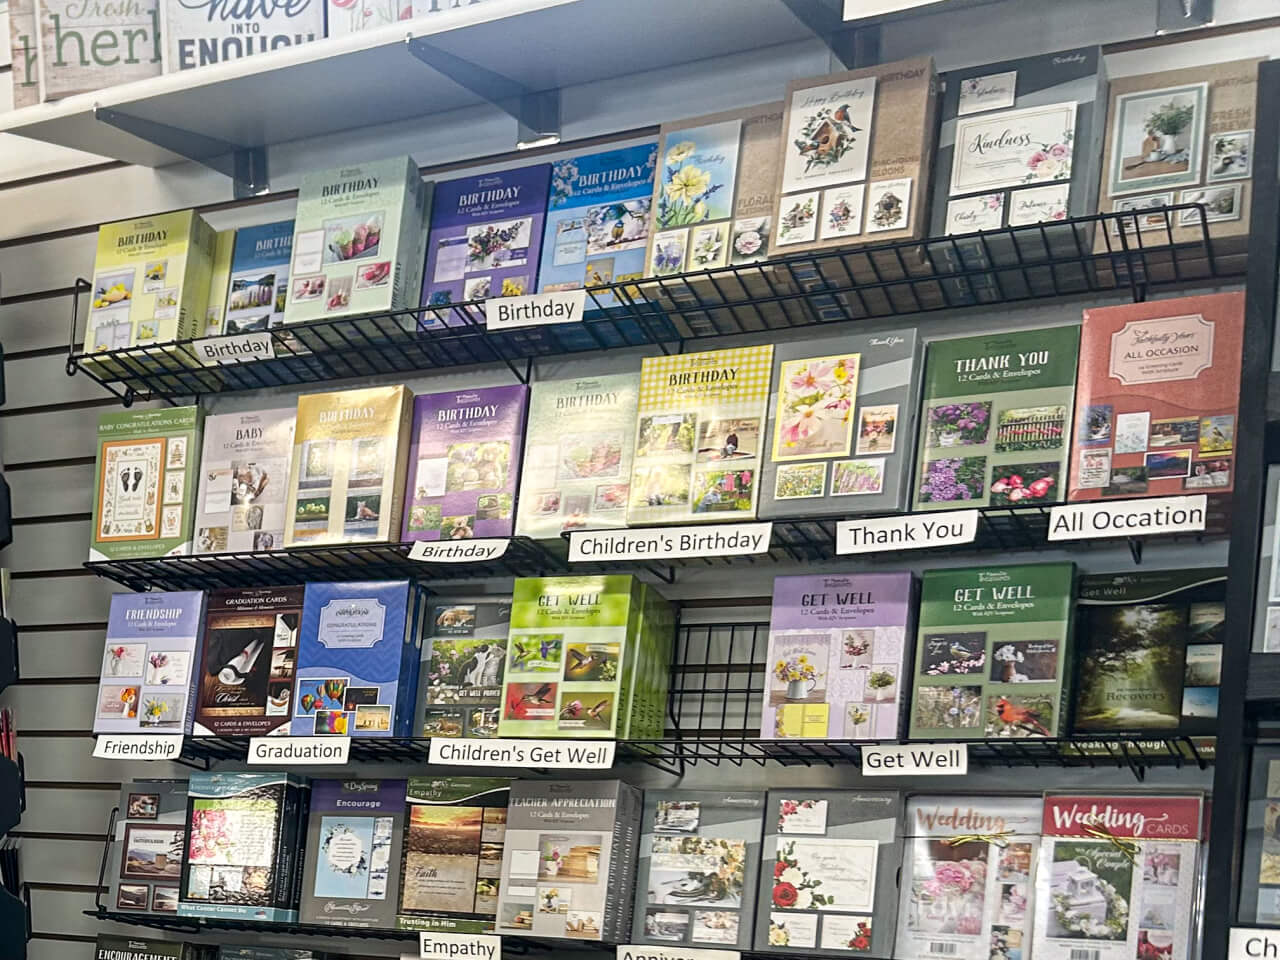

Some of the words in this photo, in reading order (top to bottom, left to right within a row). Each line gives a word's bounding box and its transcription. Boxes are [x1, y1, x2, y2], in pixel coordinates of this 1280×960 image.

[231, 23, 260, 34] INTO
[968, 129, 1032, 155] Kindness
[579, 166, 644, 188] BIRTHDAY
[321, 176, 380, 198] BIRTHDAY
[458, 185, 522, 206] BIRTHDAY
[118, 229, 169, 248] BIRTHDAY
[497, 299, 576, 323] Birthday
[203, 338, 270, 359] Birthday
[1123, 351, 1143, 360] ALL
[1145, 345, 1200, 358] OCCASION
[954, 355, 1011, 374] THANK
[1018, 350, 1050, 367] YOU
[668, 367, 740, 387] BIRTHDAY
[556, 391, 618, 410] BIRTHDAY
[319, 405, 377, 424] BIRTHDAY
[437, 404, 500, 422] BIRTHDAY
[235, 426, 265, 442] BABY
[1053, 511, 1084, 534] All
[1091, 505, 1204, 530] Occation
[580, 533, 674, 556] Children's
[679, 530, 763, 551] Birthday
[848, 523, 915, 547] Thank
[922, 521, 965, 539] You
[421, 542, 497, 561] Birthday
[225, 597, 265, 607] GRADUATION
[266, 595, 288, 604] CARDS
[538, 594, 560, 608] GET
[568, 593, 603, 607] WELL
[801, 592, 833, 608] GET
[838, 591, 876, 607] WELL
[953, 586, 986, 602] GET
[992, 584, 1036, 601] WELL
[125, 607, 183, 622] FRIENDSHIP
[1106, 690, 1168, 702] Recovery
[104, 740, 176, 758] Friendship
[255, 743, 344, 759] Graduation
[439, 743, 525, 763] Children's
[530, 746, 562, 766] Get
[566, 745, 608, 765] Well
[866, 751, 910, 770] Get
[914, 750, 962, 769] Well
[408, 788, 443, 799] Empathy
[336, 799, 382, 809] Encourage
[510, 798, 548, 809] TEACHER
[550, 797, 618, 810] APPRECIATION
[917, 806, 1008, 833] Wedding
[1052, 803, 1146, 837] Wedding
[1146, 824, 1190, 835] CARDS
[414, 864, 439, 880] Faith
[399, 917, 429, 929] Trusting
[431, 919, 438, 928] in
[439, 919, 457, 929] Him
[423, 938, 496, 960] Empathy
